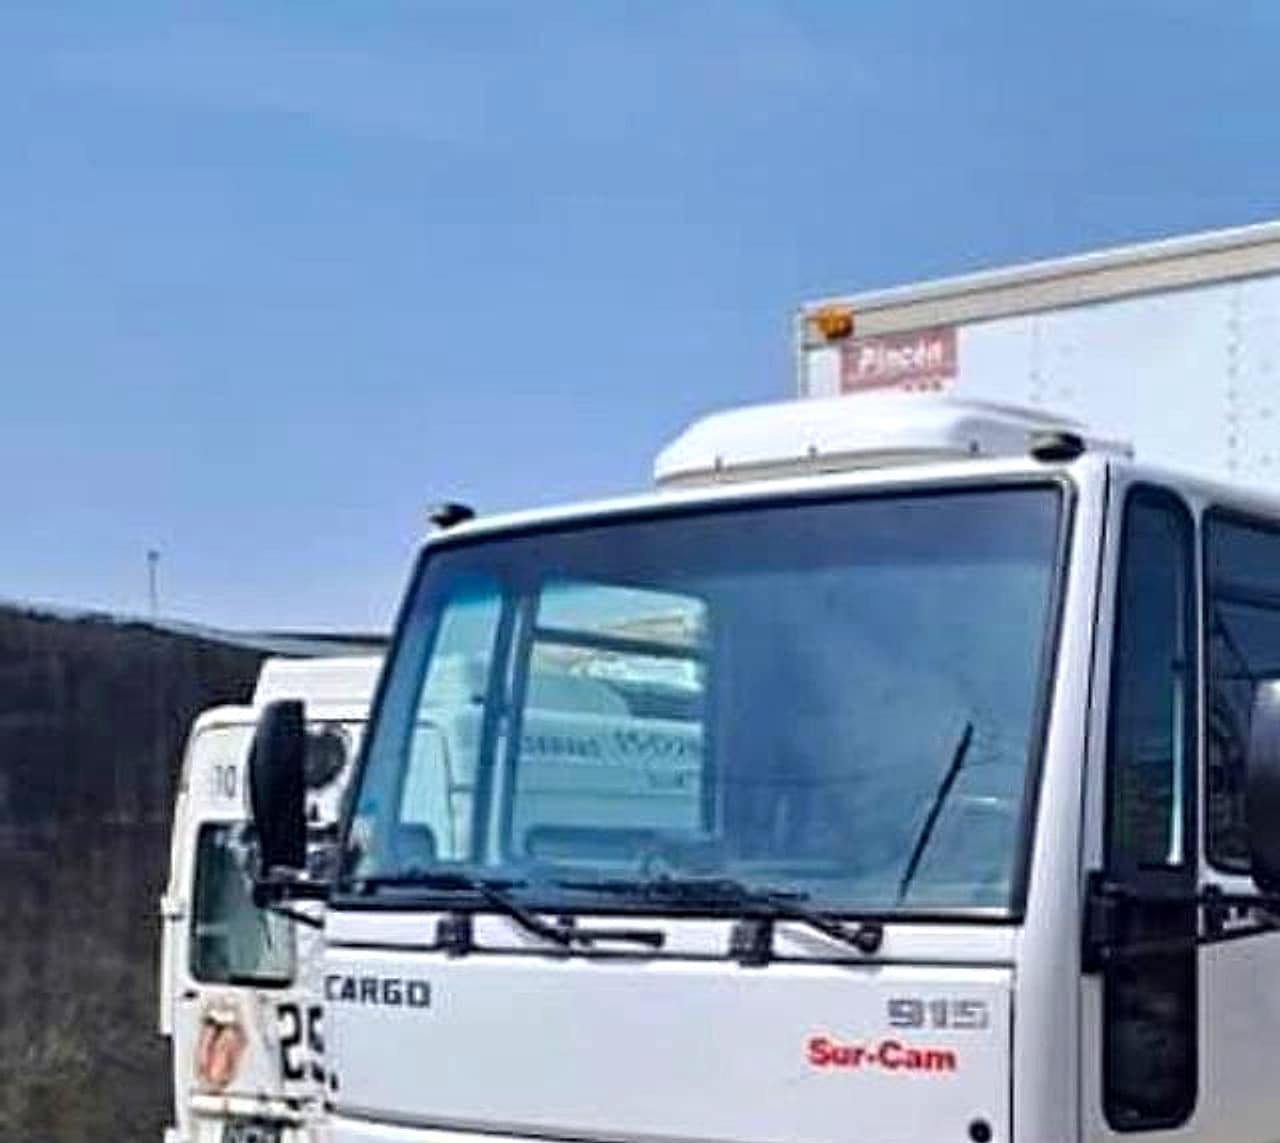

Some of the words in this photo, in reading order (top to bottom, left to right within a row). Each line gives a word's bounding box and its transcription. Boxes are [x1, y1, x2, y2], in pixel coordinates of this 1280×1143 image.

[325, 975, 431, 1008] CARGO
[887, 998, 989, 1029] 915
[807, 1036, 957, 1071] Sur-Cam
